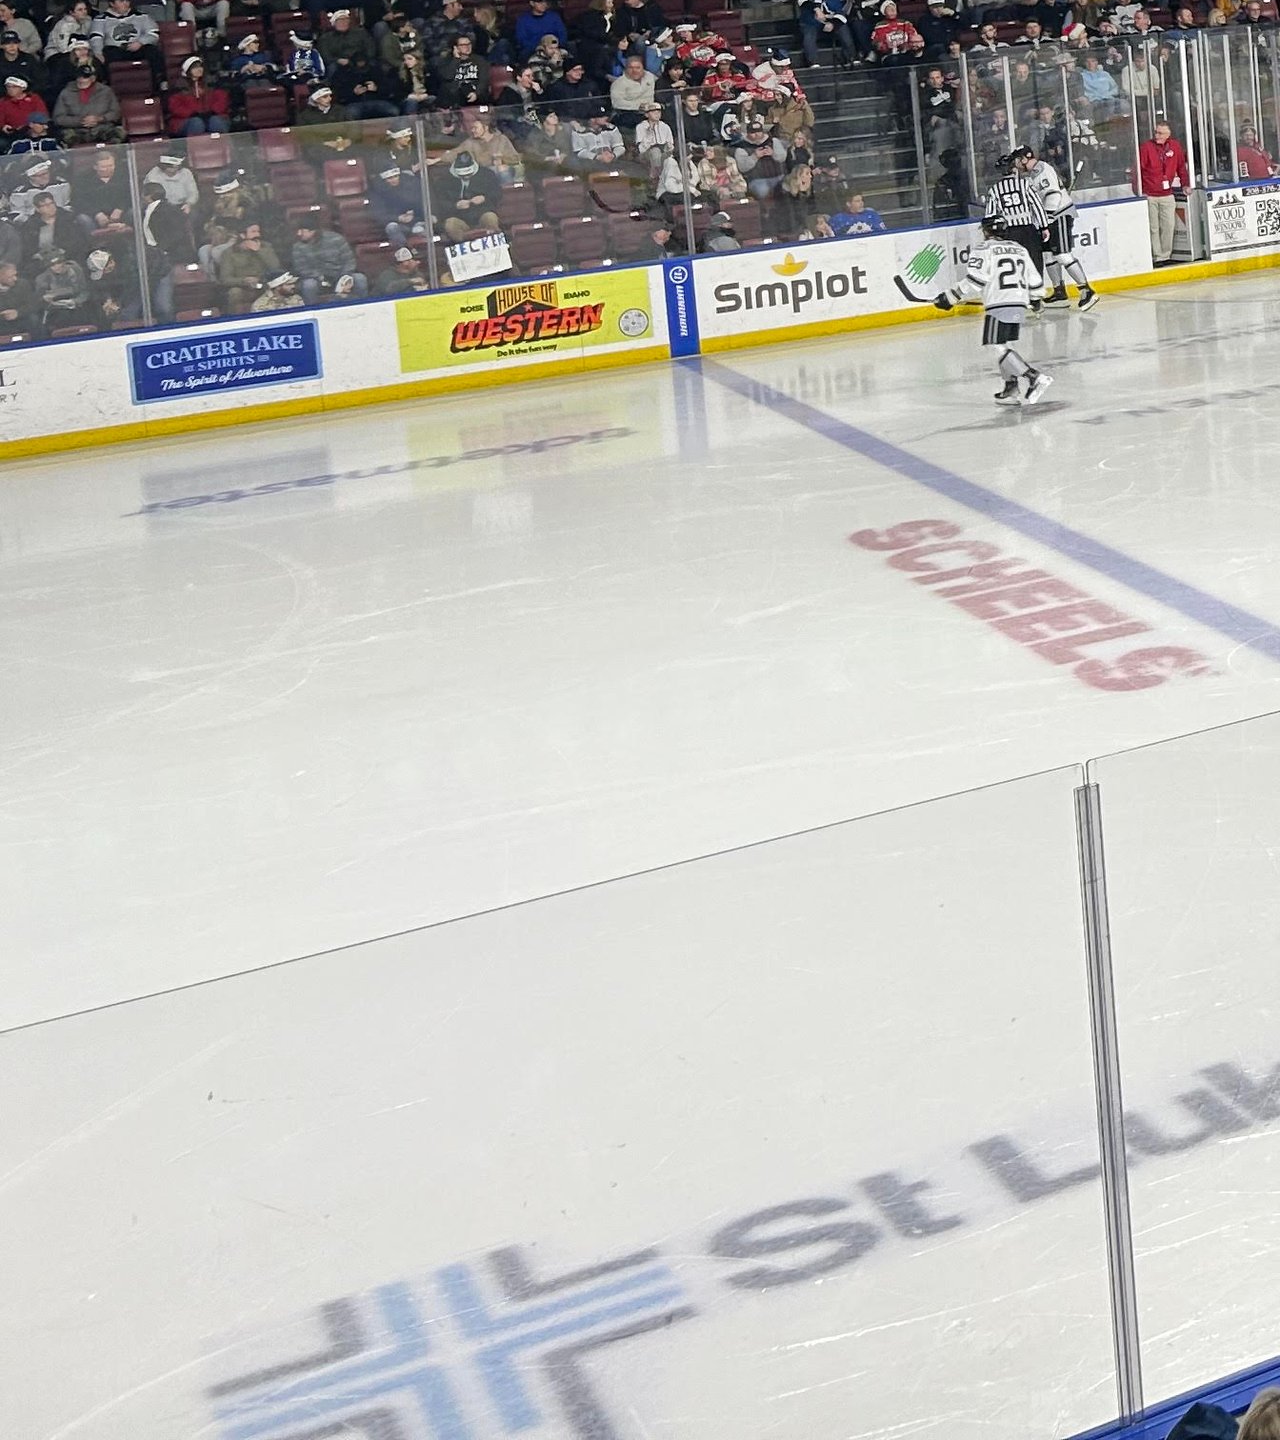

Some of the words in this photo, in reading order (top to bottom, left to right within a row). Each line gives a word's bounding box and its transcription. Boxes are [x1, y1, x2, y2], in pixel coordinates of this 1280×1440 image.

[1002, 192, 1021, 207] 58
[1213, 205, 1246, 221] WOOD
[499, 284, 535, 307] HOUSE
[540, 281, 557, 298] OF
[563, 289, 591, 300] IDAHO
[714, 265, 869, 315] Simplot
[460, 304, 485, 314] BOISE
[449, 302, 605, 353] WESTERN
[146, 339, 237, 369] CRATER
[242, 334, 303, 353] LAKE
[197, 354, 256, 372] SPIRITS
[496, 348, 508, 358] Do
[515, 346, 528, 356] the
[160, 378, 184, 392] The
[184, 373, 218, 390] Spirit
[219, 370, 233, 384] of
[232, 364, 294, 382] Adventure
[848, 518, 1210, 692] SCHEELS
[706, 1167, 963, 1292] St
